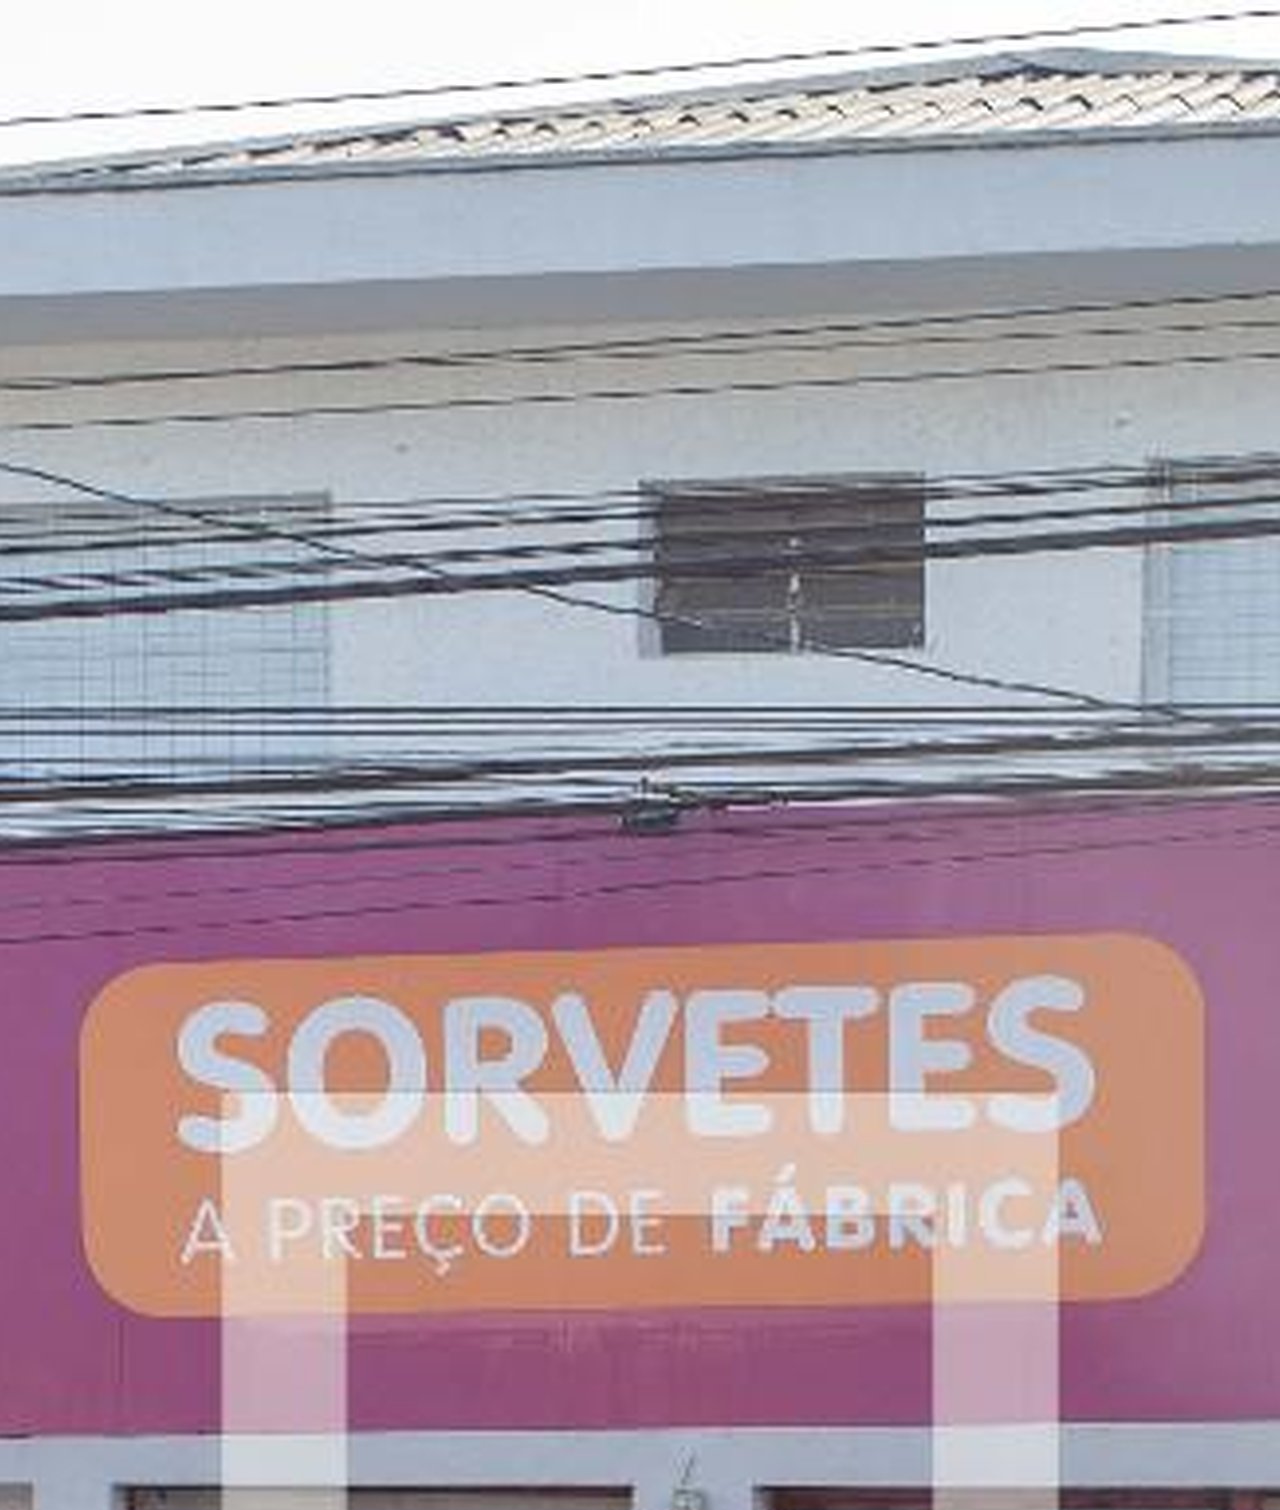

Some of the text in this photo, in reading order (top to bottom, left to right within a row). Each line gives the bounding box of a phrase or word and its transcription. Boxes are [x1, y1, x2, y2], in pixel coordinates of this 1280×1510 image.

[175, 974, 1098, 1155] SORVETES
[179, 1163, 1106, 1276] A PREÇO DE FÁBRICA
